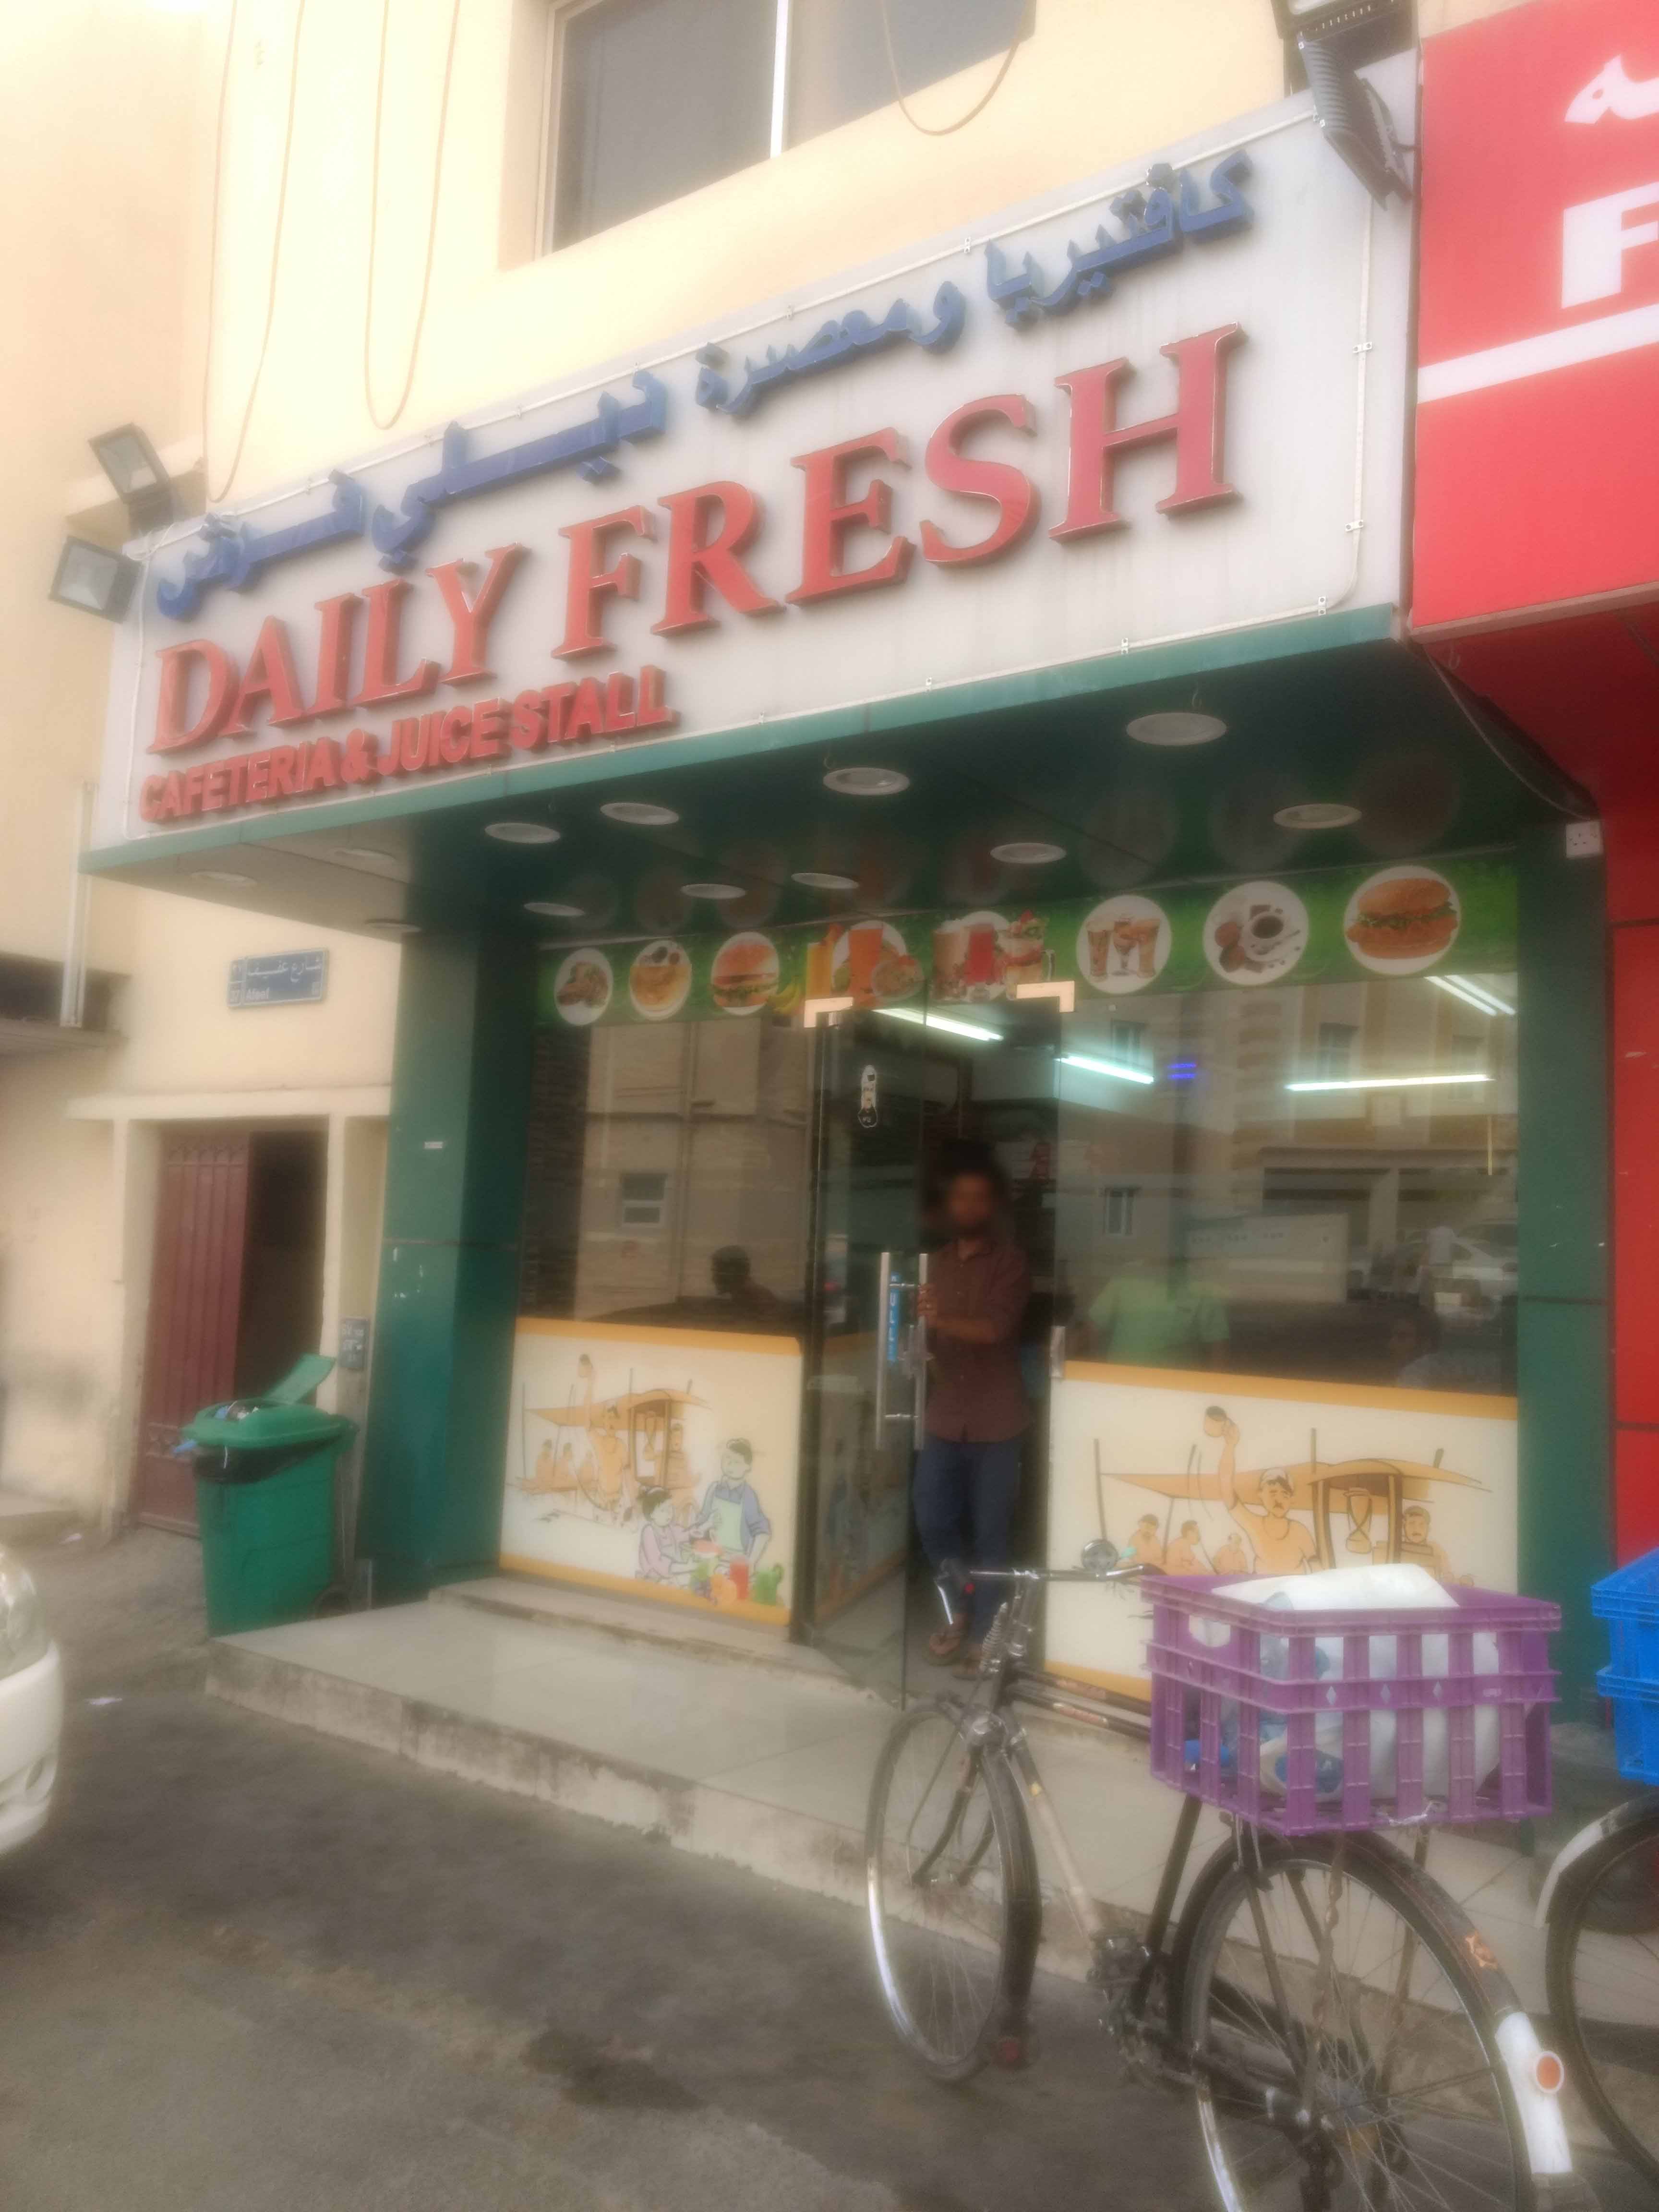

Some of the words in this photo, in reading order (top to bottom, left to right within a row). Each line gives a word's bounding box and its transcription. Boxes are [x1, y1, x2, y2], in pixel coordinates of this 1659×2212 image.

[147, 542, 530, 755] DAILY
[552, 321, 1248, 661] FRESH
[139, 736, 340, 824] CAFETERIA
[340, 728, 378, 784] &
[377, 696, 513, 776] JUICE
[510, 664, 678, 751] STALL
